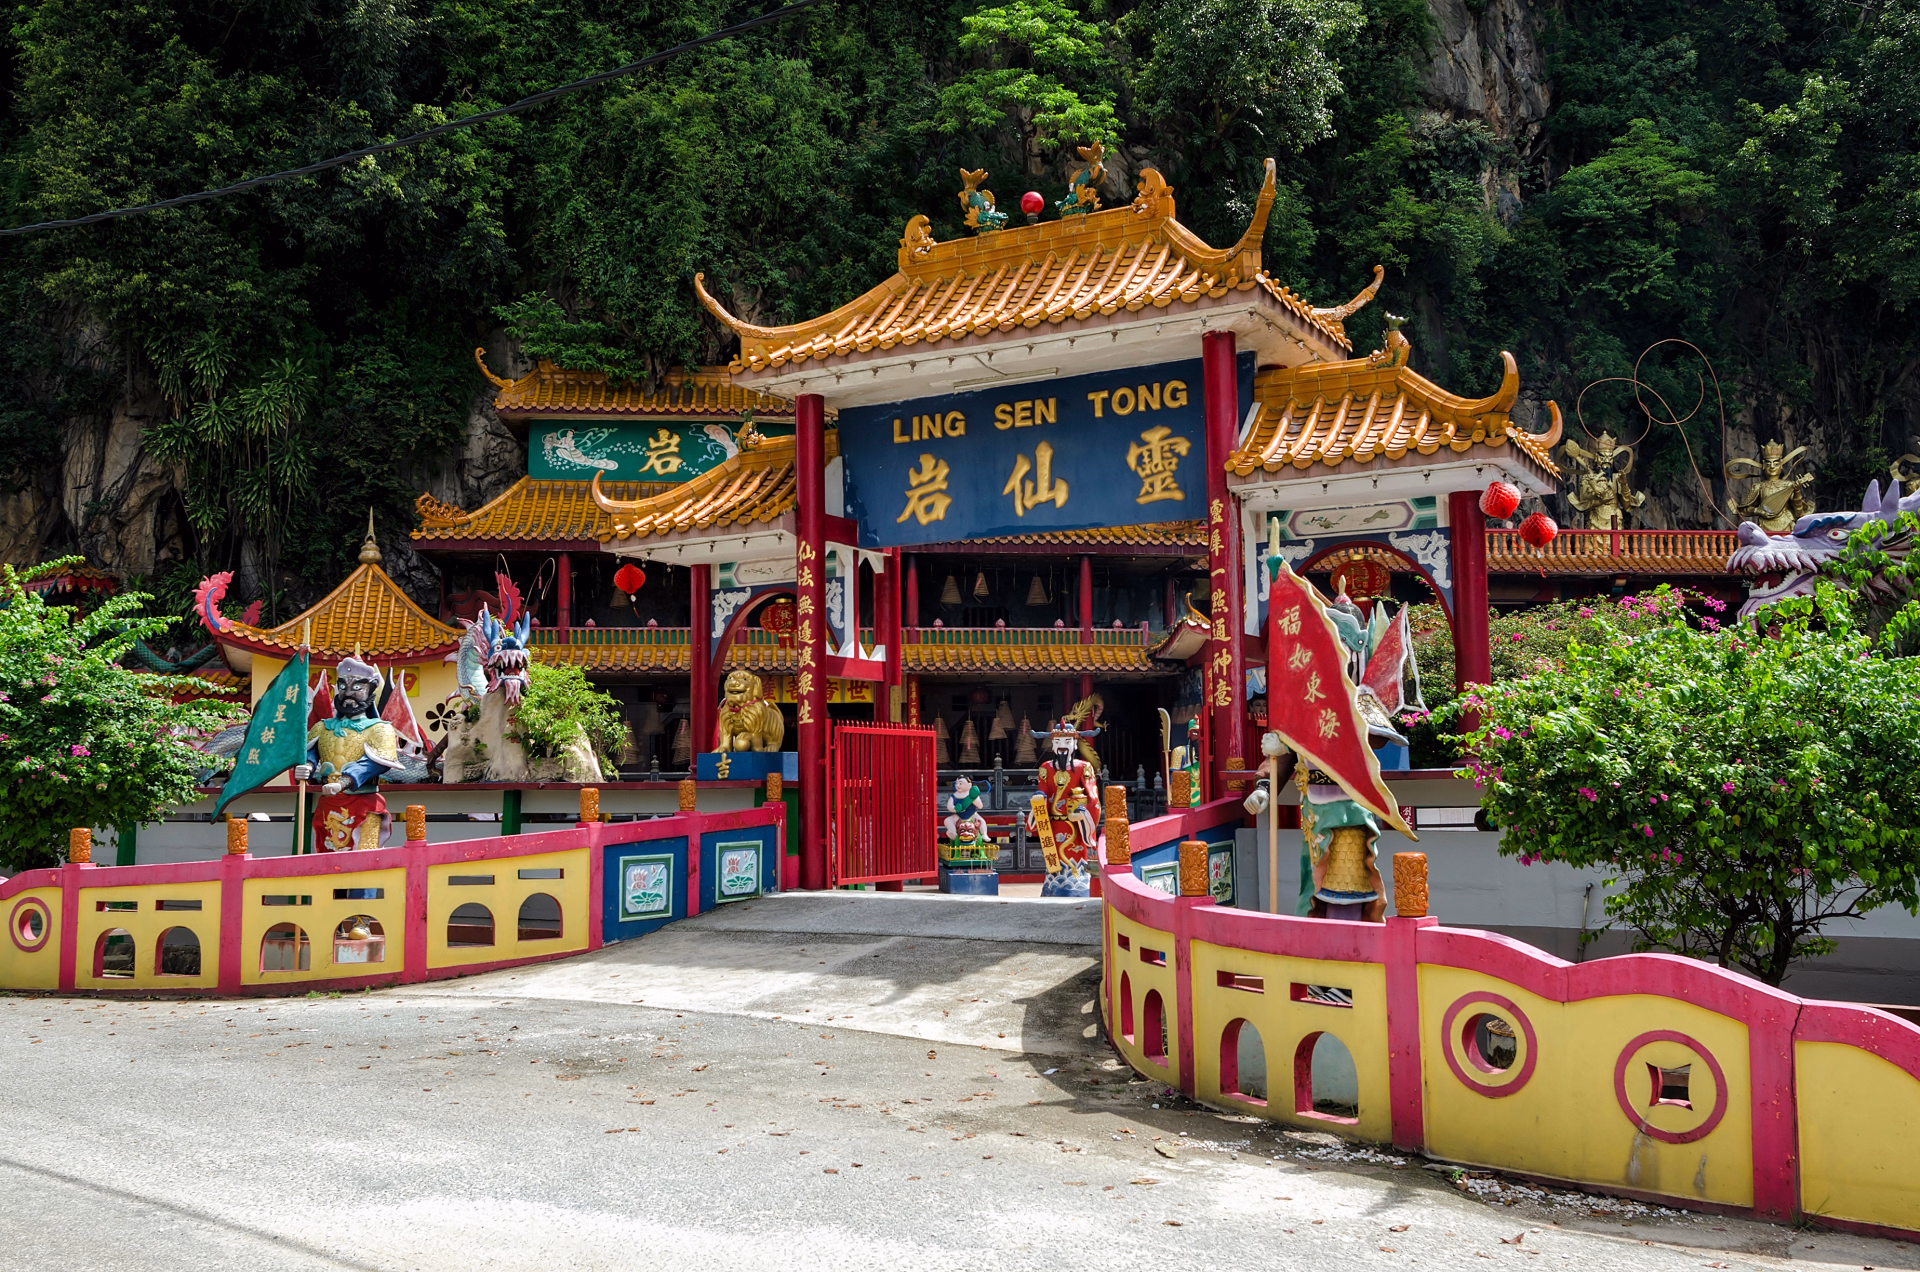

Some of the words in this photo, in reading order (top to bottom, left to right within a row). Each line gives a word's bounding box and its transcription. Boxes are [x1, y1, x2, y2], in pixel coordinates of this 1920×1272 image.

[893, 410, 966, 444] LING
[993, 397, 1057, 430] SEN
[1087, 379, 1188, 418] TONG
[638, 427, 684, 476] 岩
[1278, 604, 1341, 739] 福如東海
[245, 683, 300, 765] 財星拱照
[715, 753, 732, 780] 吉
[1033, 804, 1058, 868] 招財進寶
